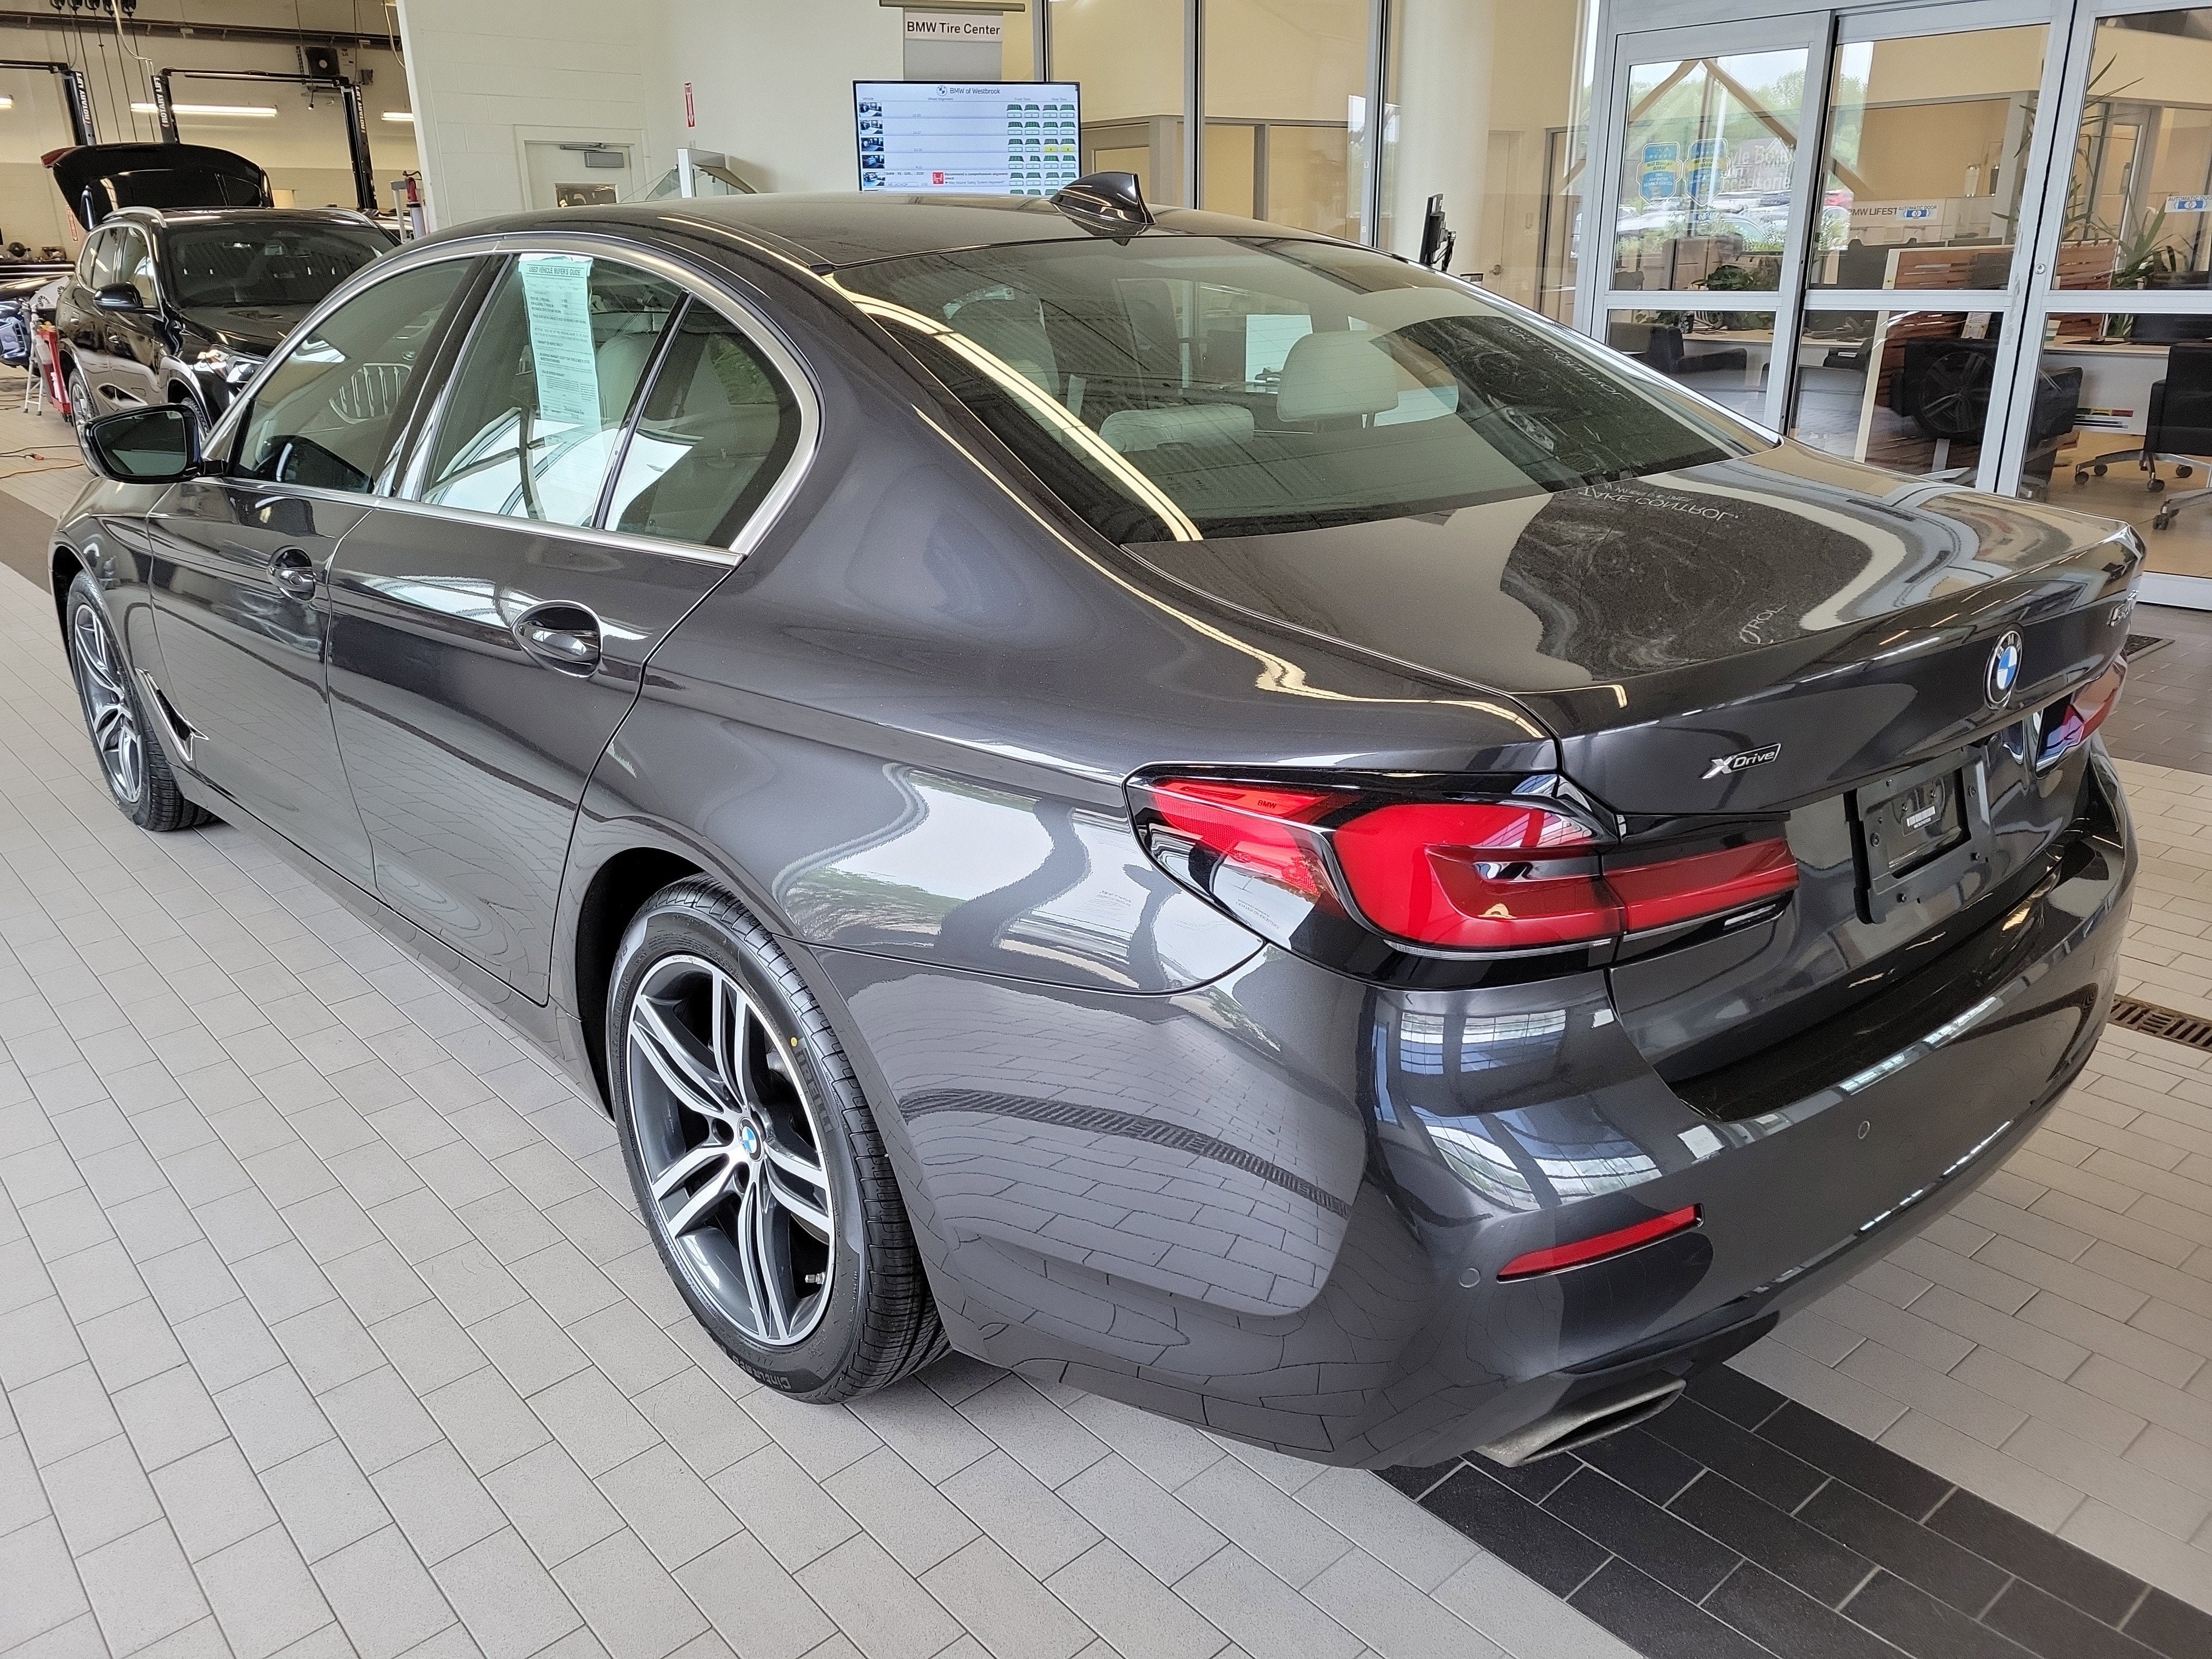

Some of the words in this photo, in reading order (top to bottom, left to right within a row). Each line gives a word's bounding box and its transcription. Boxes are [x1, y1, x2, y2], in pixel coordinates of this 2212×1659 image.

[907, 21, 936, 33] BMW
[939, 22, 960, 33] Tire
[964, 23, 1001, 35] Center
[76, 72, 84, 88] LIFT
[154, 76, 162, 92] LIFT
[79, 89, 91, 120] ROTARY
[156, 93, 169, 124] ROTARY
[1869, 207, 1898, 216] LIFEST
[1257, 799, 1277, 809] BMW
